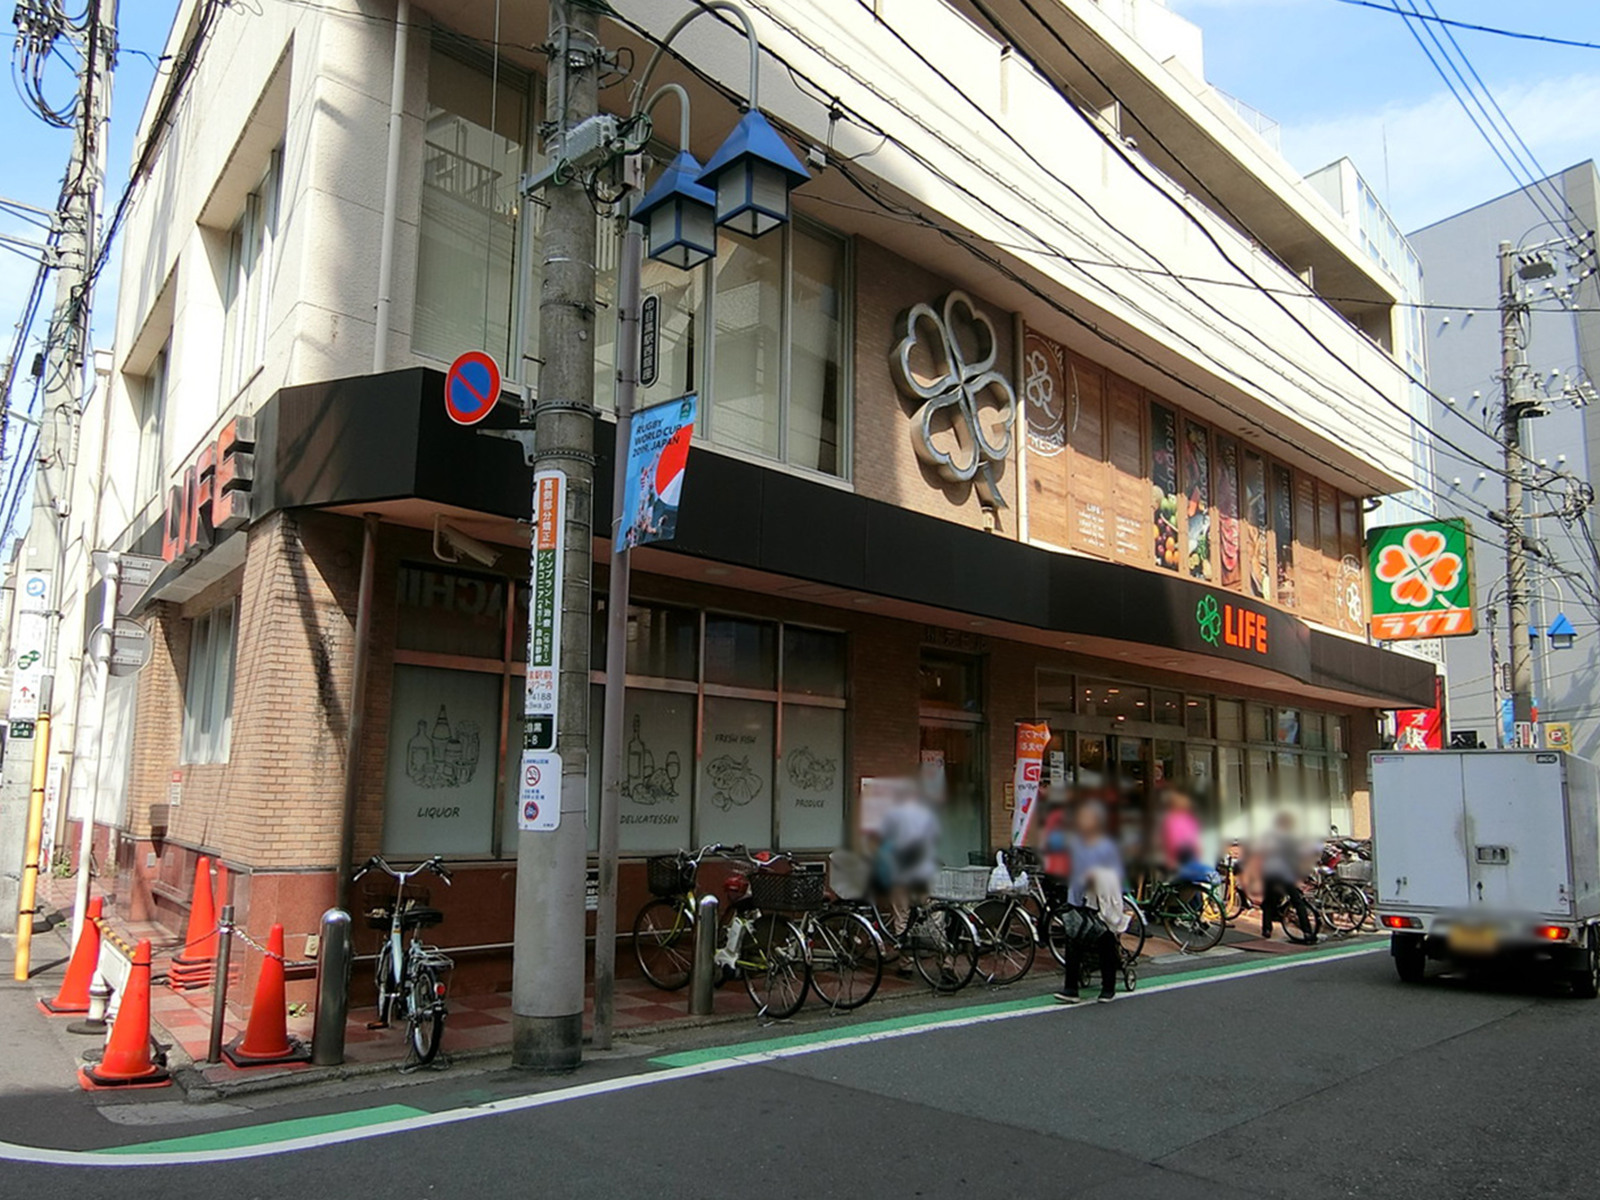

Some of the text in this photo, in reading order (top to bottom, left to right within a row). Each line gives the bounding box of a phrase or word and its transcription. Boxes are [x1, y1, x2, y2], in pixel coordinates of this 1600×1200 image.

[636, 418, 664, 433] RUGBY
[634, 424, 682, 445] WORLD CUP
[651, 435, 680, 451] JAPAN
[1224, 604, 1268, 654] LIFE
[1380, 612, 1462, 636] ライフ
[715, 734, 757, 744] FRESH FISH
[795, 799, 825, 808] PRODUCE
[417, 807, 460, 819] LIQUOR
[619, 815, 680, 825] DELICATESSEN
